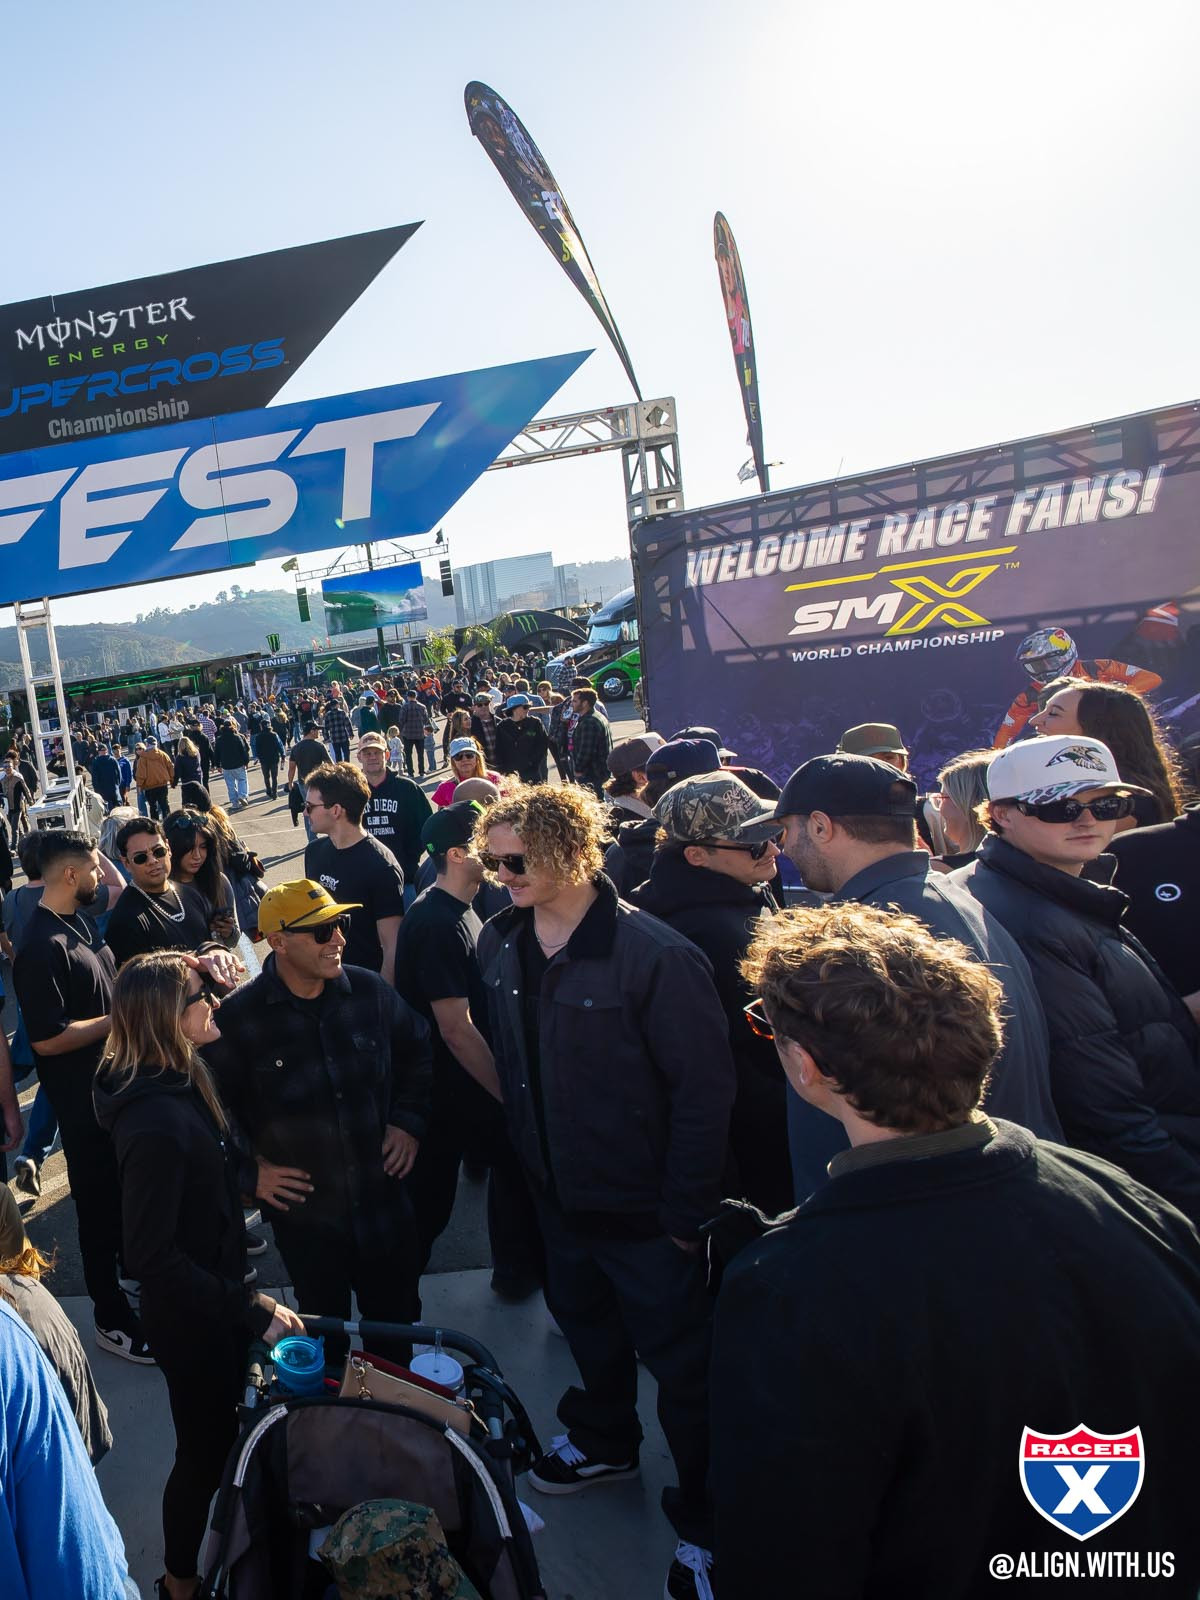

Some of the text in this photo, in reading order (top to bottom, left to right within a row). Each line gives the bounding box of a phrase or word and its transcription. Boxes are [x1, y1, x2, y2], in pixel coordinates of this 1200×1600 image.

[14, 297, 196, 351] MONSTER
[48, 334, 169, 366] ENERGY
[48, 398, 190, 439] Championship
[685, 463, 1167, 588] WELCOME RACE FANS!
[788, 565, 1000, 637] SMX
[258, 656, 296, 668] FINISH
[792, 630, 1005, 662] WORLD CHAMPIONSHIP
[374, 799, 398, 813] DIEGO
